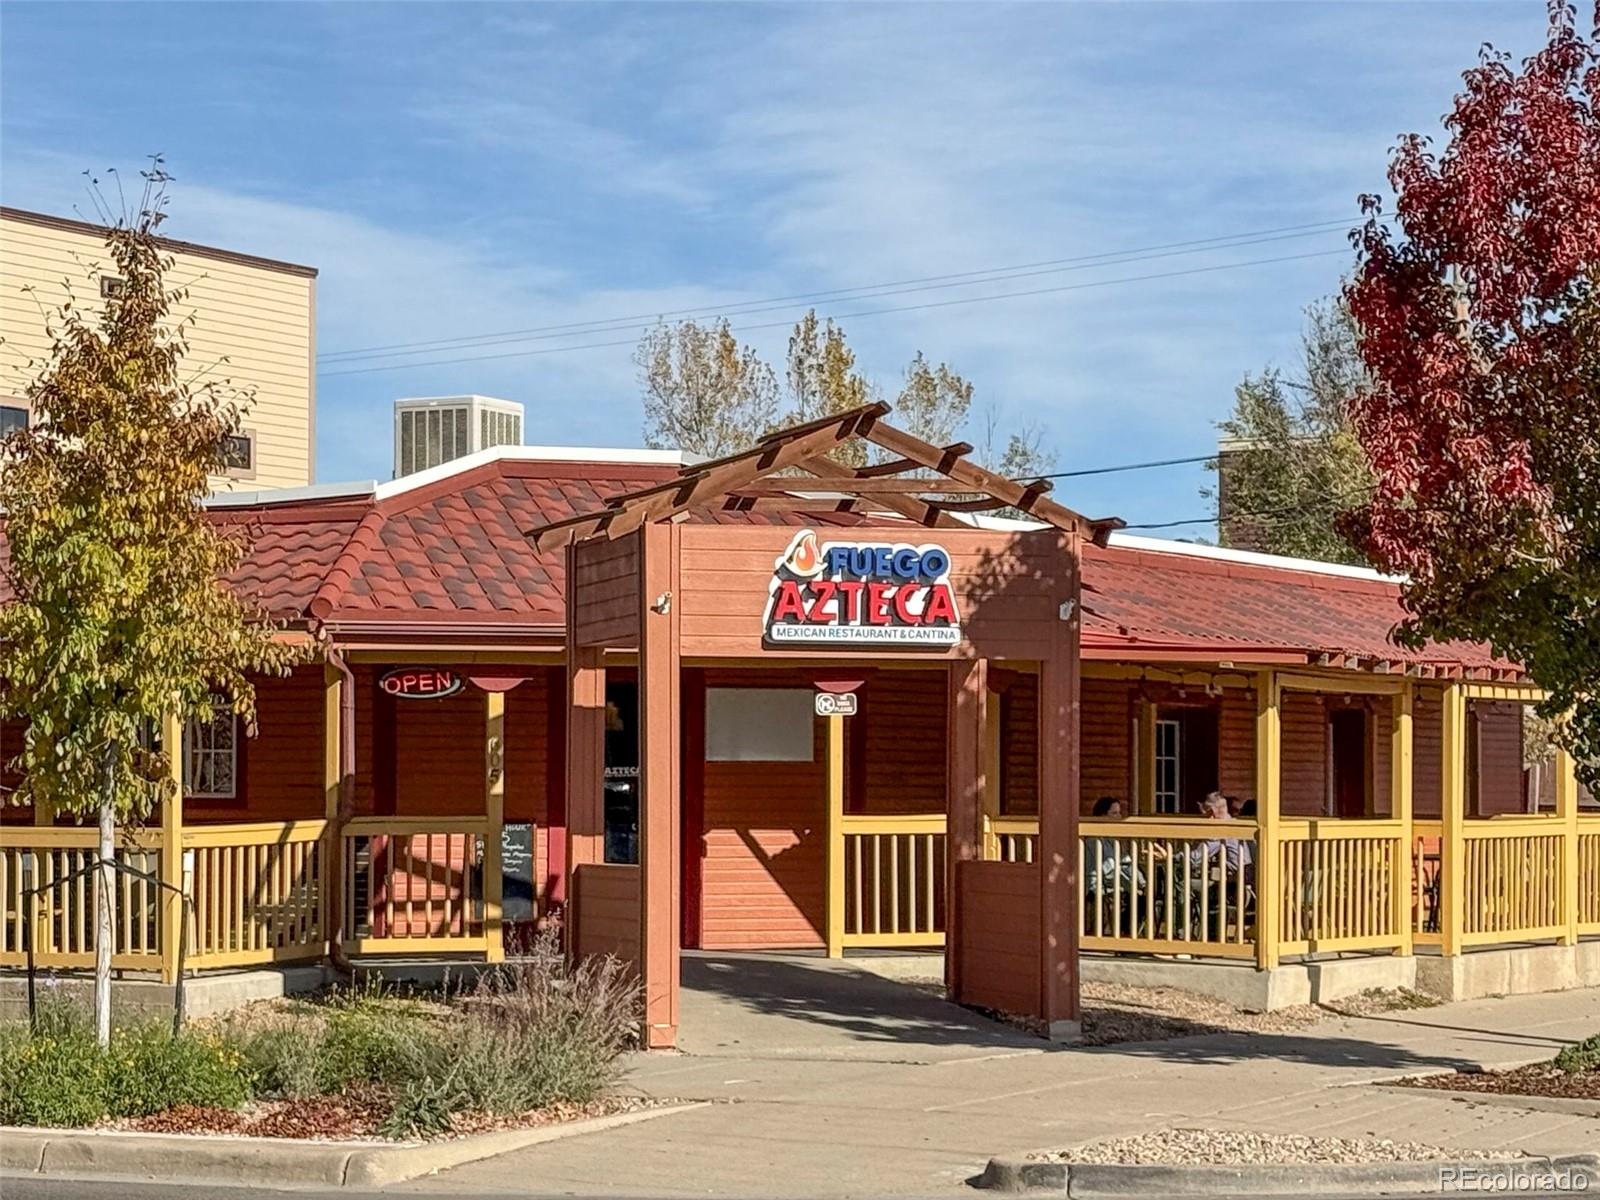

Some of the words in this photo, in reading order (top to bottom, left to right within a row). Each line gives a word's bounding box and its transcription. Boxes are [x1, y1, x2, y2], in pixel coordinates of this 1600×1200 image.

[828, 546, 949, 578] FUEGO
[773, 580, 957, 624] AZTECA
[776, 627, 827, 638] MEXICAN
[829, 628, 898, 639] RESTAURANT
[899, 631, 907, 639] &
[908, 629, 956, 640] CANTINA
[384, 671, 452, 695] OPEN
